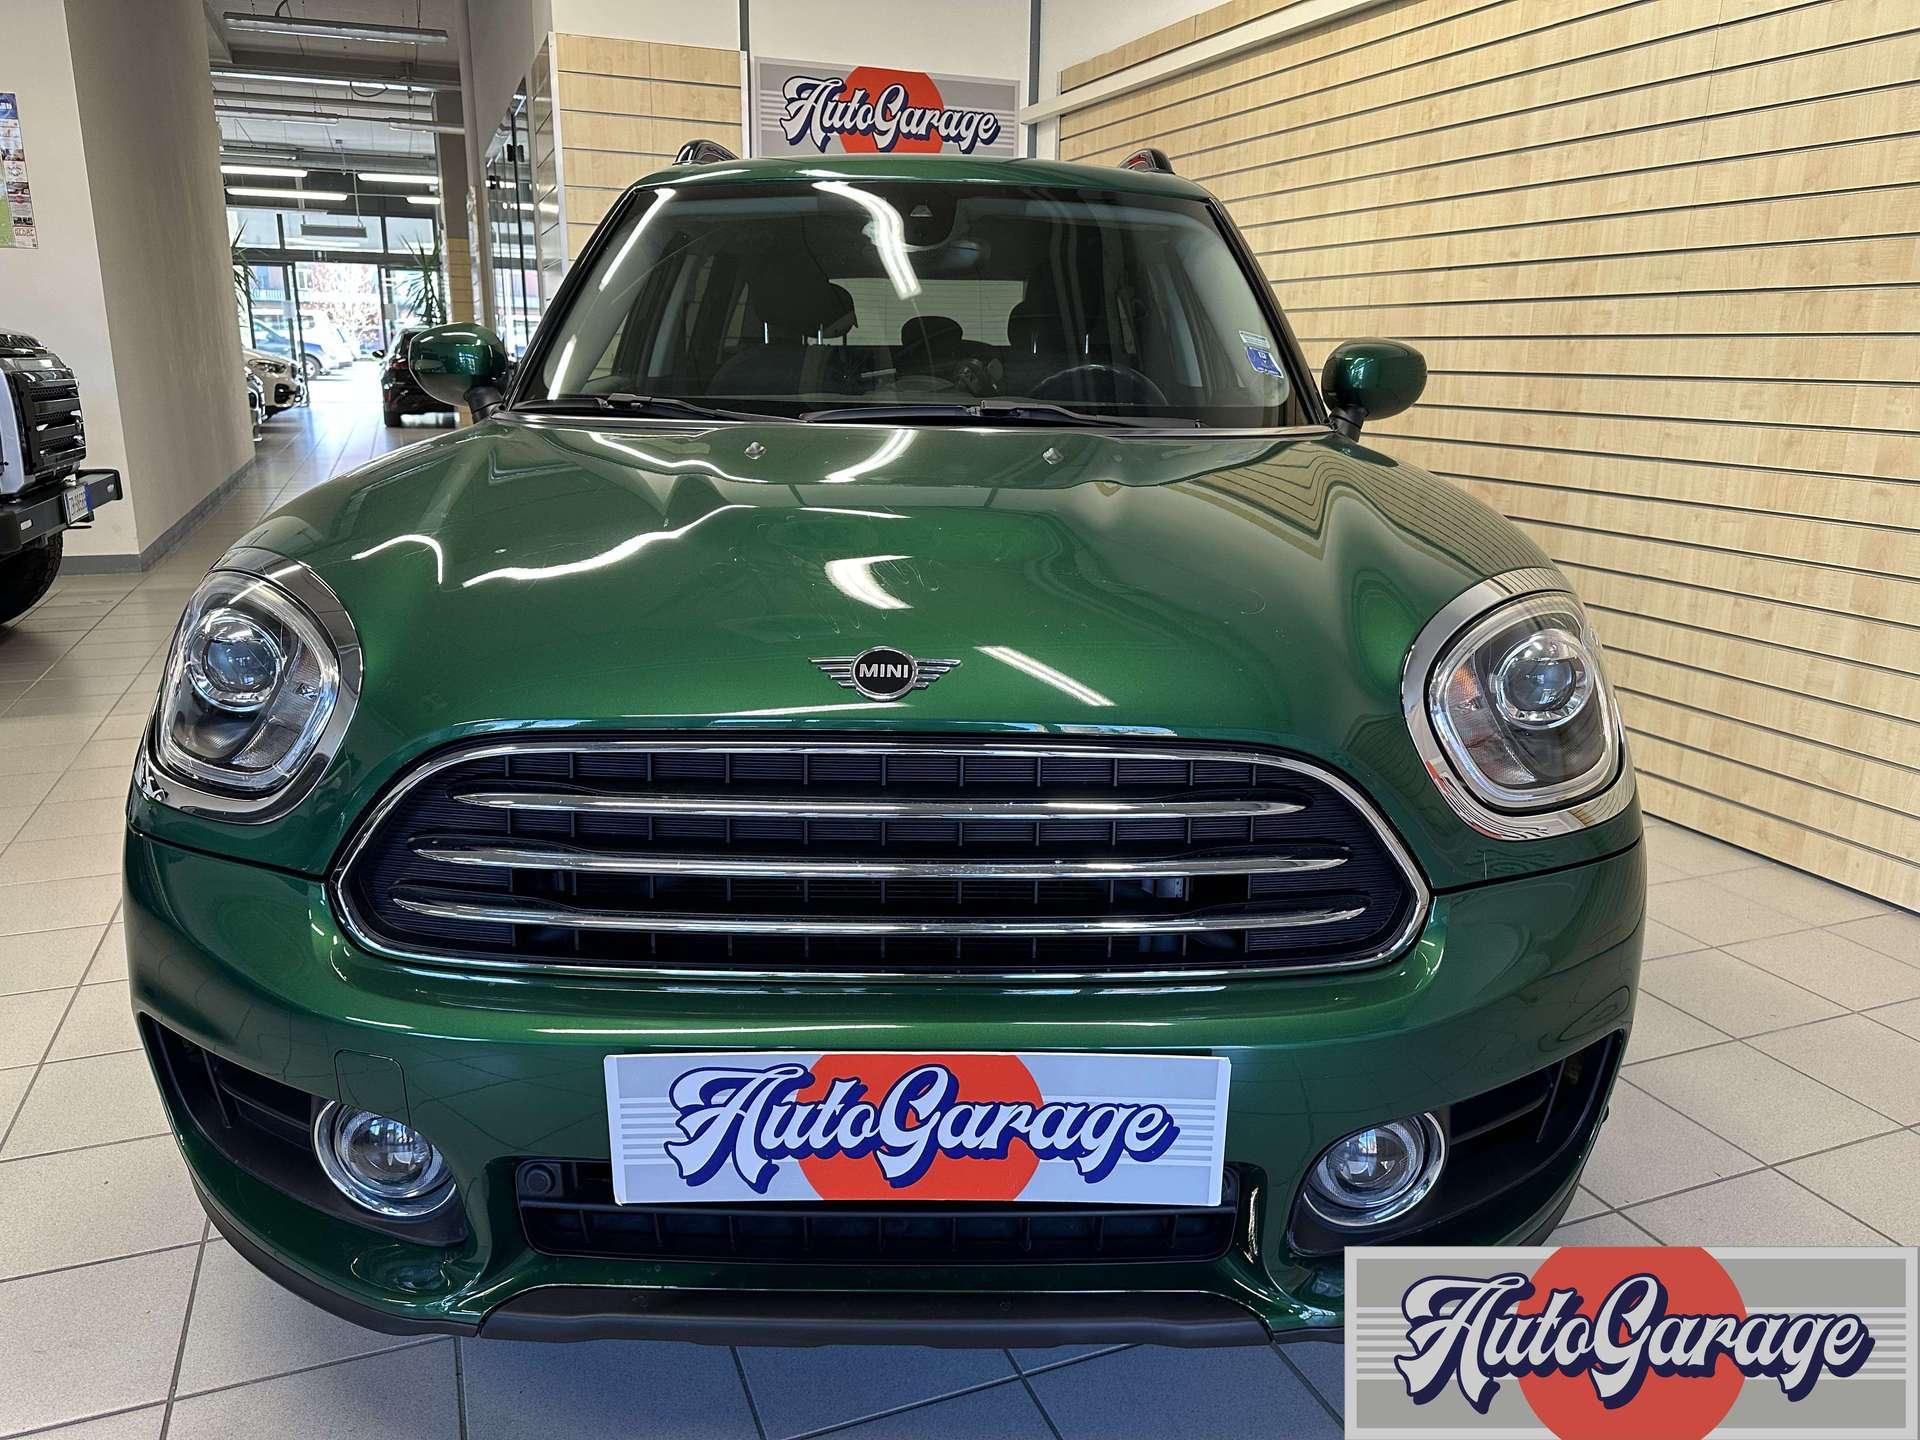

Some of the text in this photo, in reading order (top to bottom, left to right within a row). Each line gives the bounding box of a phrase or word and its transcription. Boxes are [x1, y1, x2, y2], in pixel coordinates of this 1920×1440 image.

[779, 76, 1000, 154] AutoGarage
[859, 663, 909, 679] MINI
[664, 1063, 1180, 1194] AutoGarage
